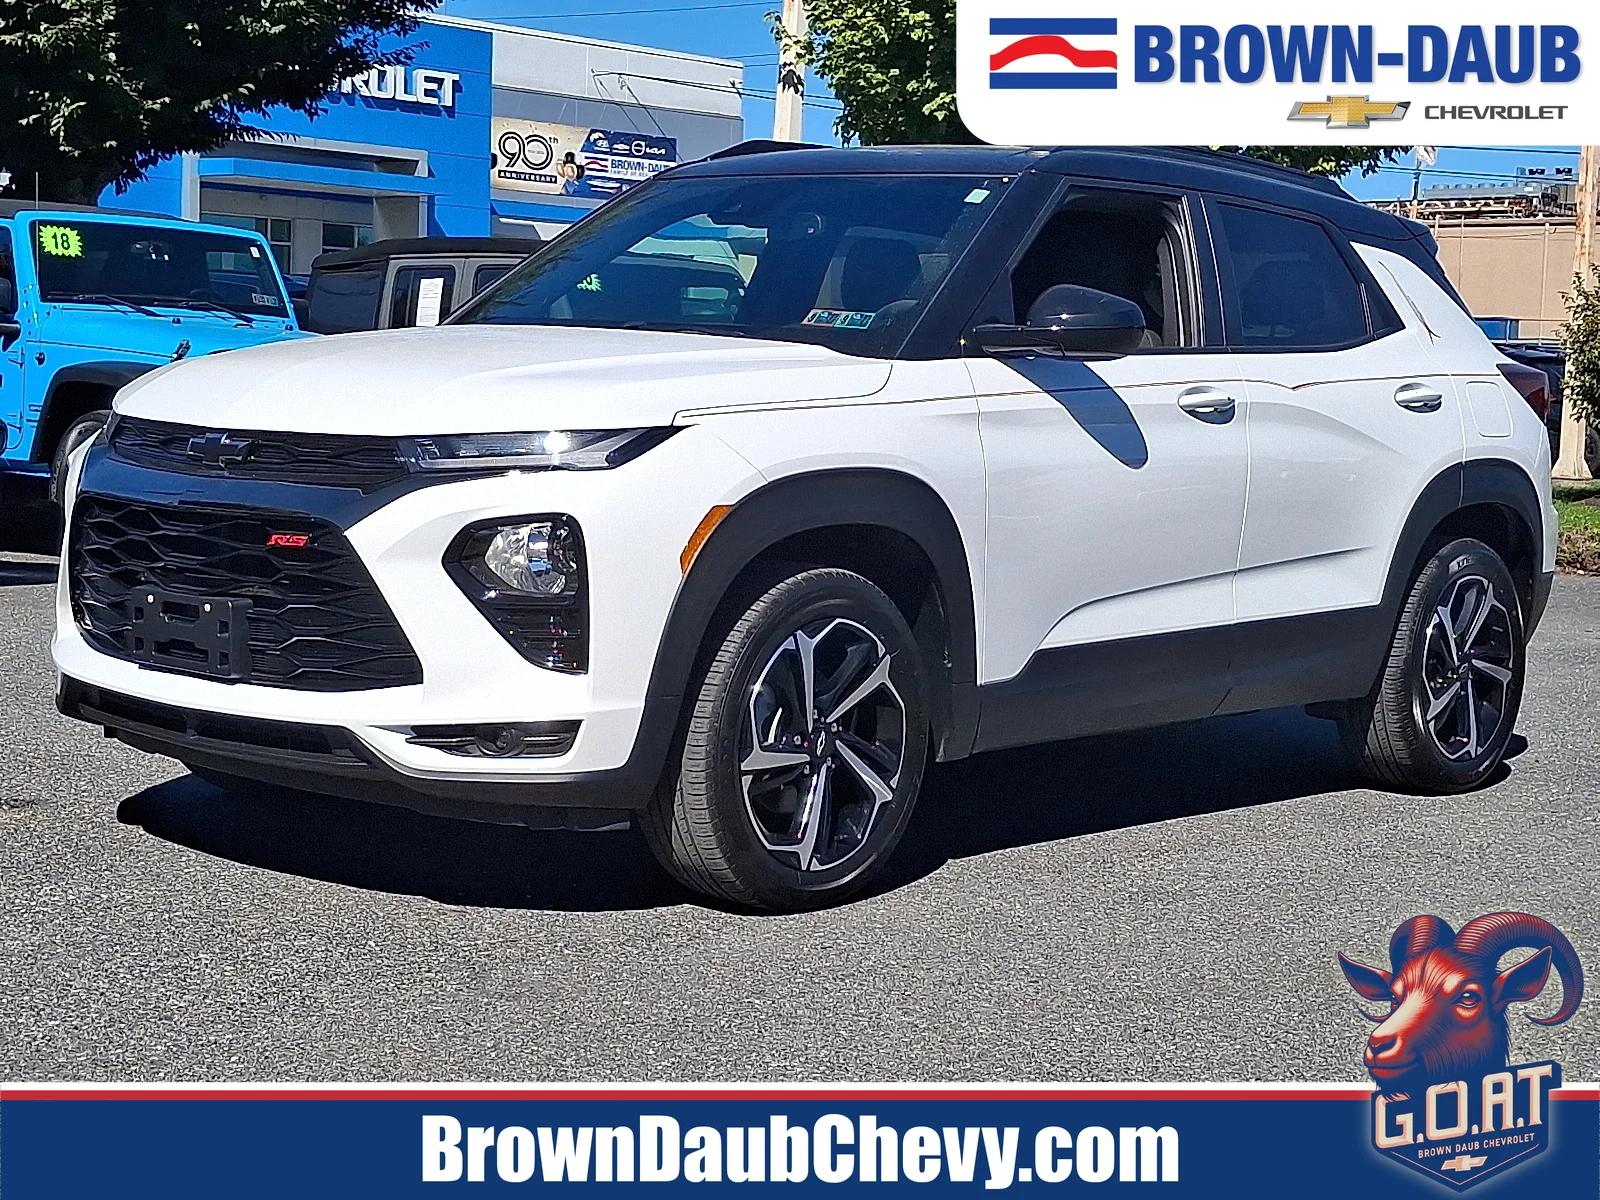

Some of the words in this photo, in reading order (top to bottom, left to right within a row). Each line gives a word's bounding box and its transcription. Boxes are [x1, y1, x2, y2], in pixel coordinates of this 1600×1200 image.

[499, 171, 556, 183] ANNIVERSARY
[51, 231, 71, 251] 18
[266, 534, 309, 547] RS
